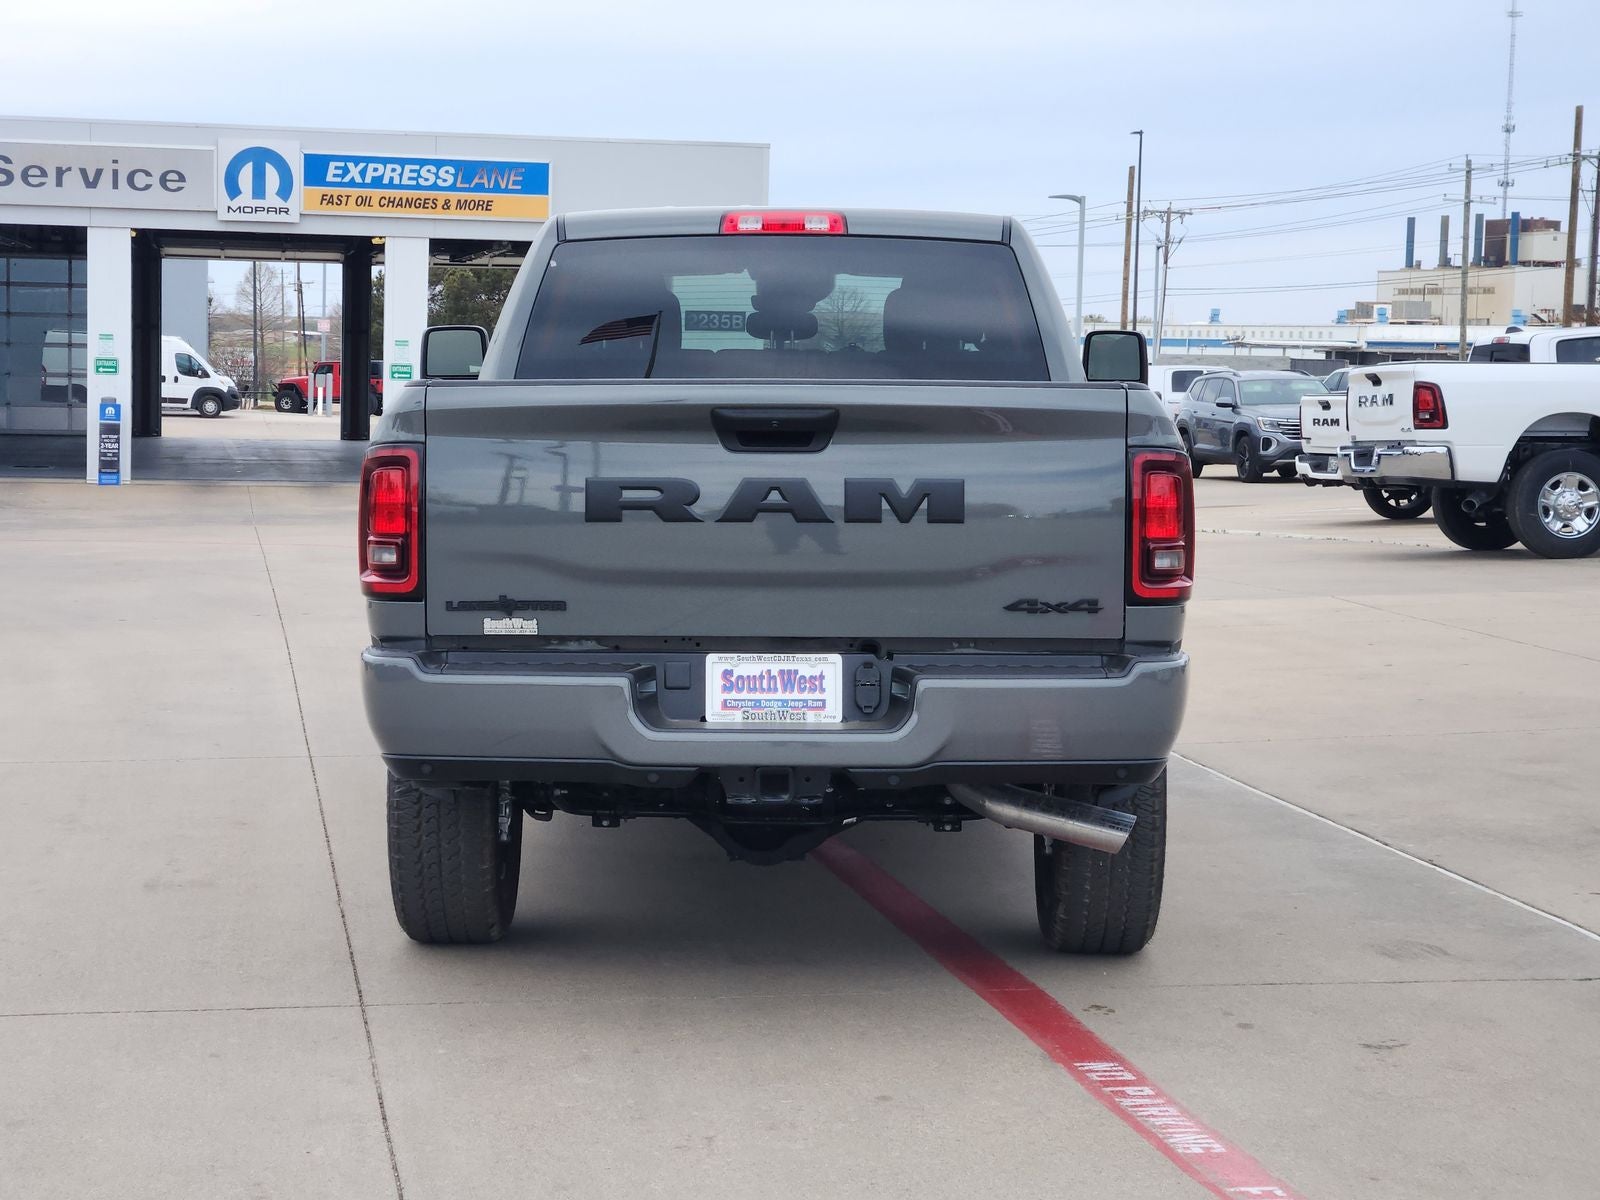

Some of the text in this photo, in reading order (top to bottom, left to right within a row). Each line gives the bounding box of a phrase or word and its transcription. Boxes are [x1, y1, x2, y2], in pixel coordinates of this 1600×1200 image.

[0, 154, 187, 192] Service
[227, 205, 290, 216] MOPAR
[319, 194, 493, 212] FAST OIL CHANGES & MORE
[1358, 393, 1394, 408] RAM
[1312, 418, 1340, 427] RAM
[585, 476, 965, 523] RAM
[721, 669, 826, 694] SouthWest
[726, 699, 823, 708] Chrysler Dodge Jeep Ram
[742, 710, 807, 722] SouthWest
